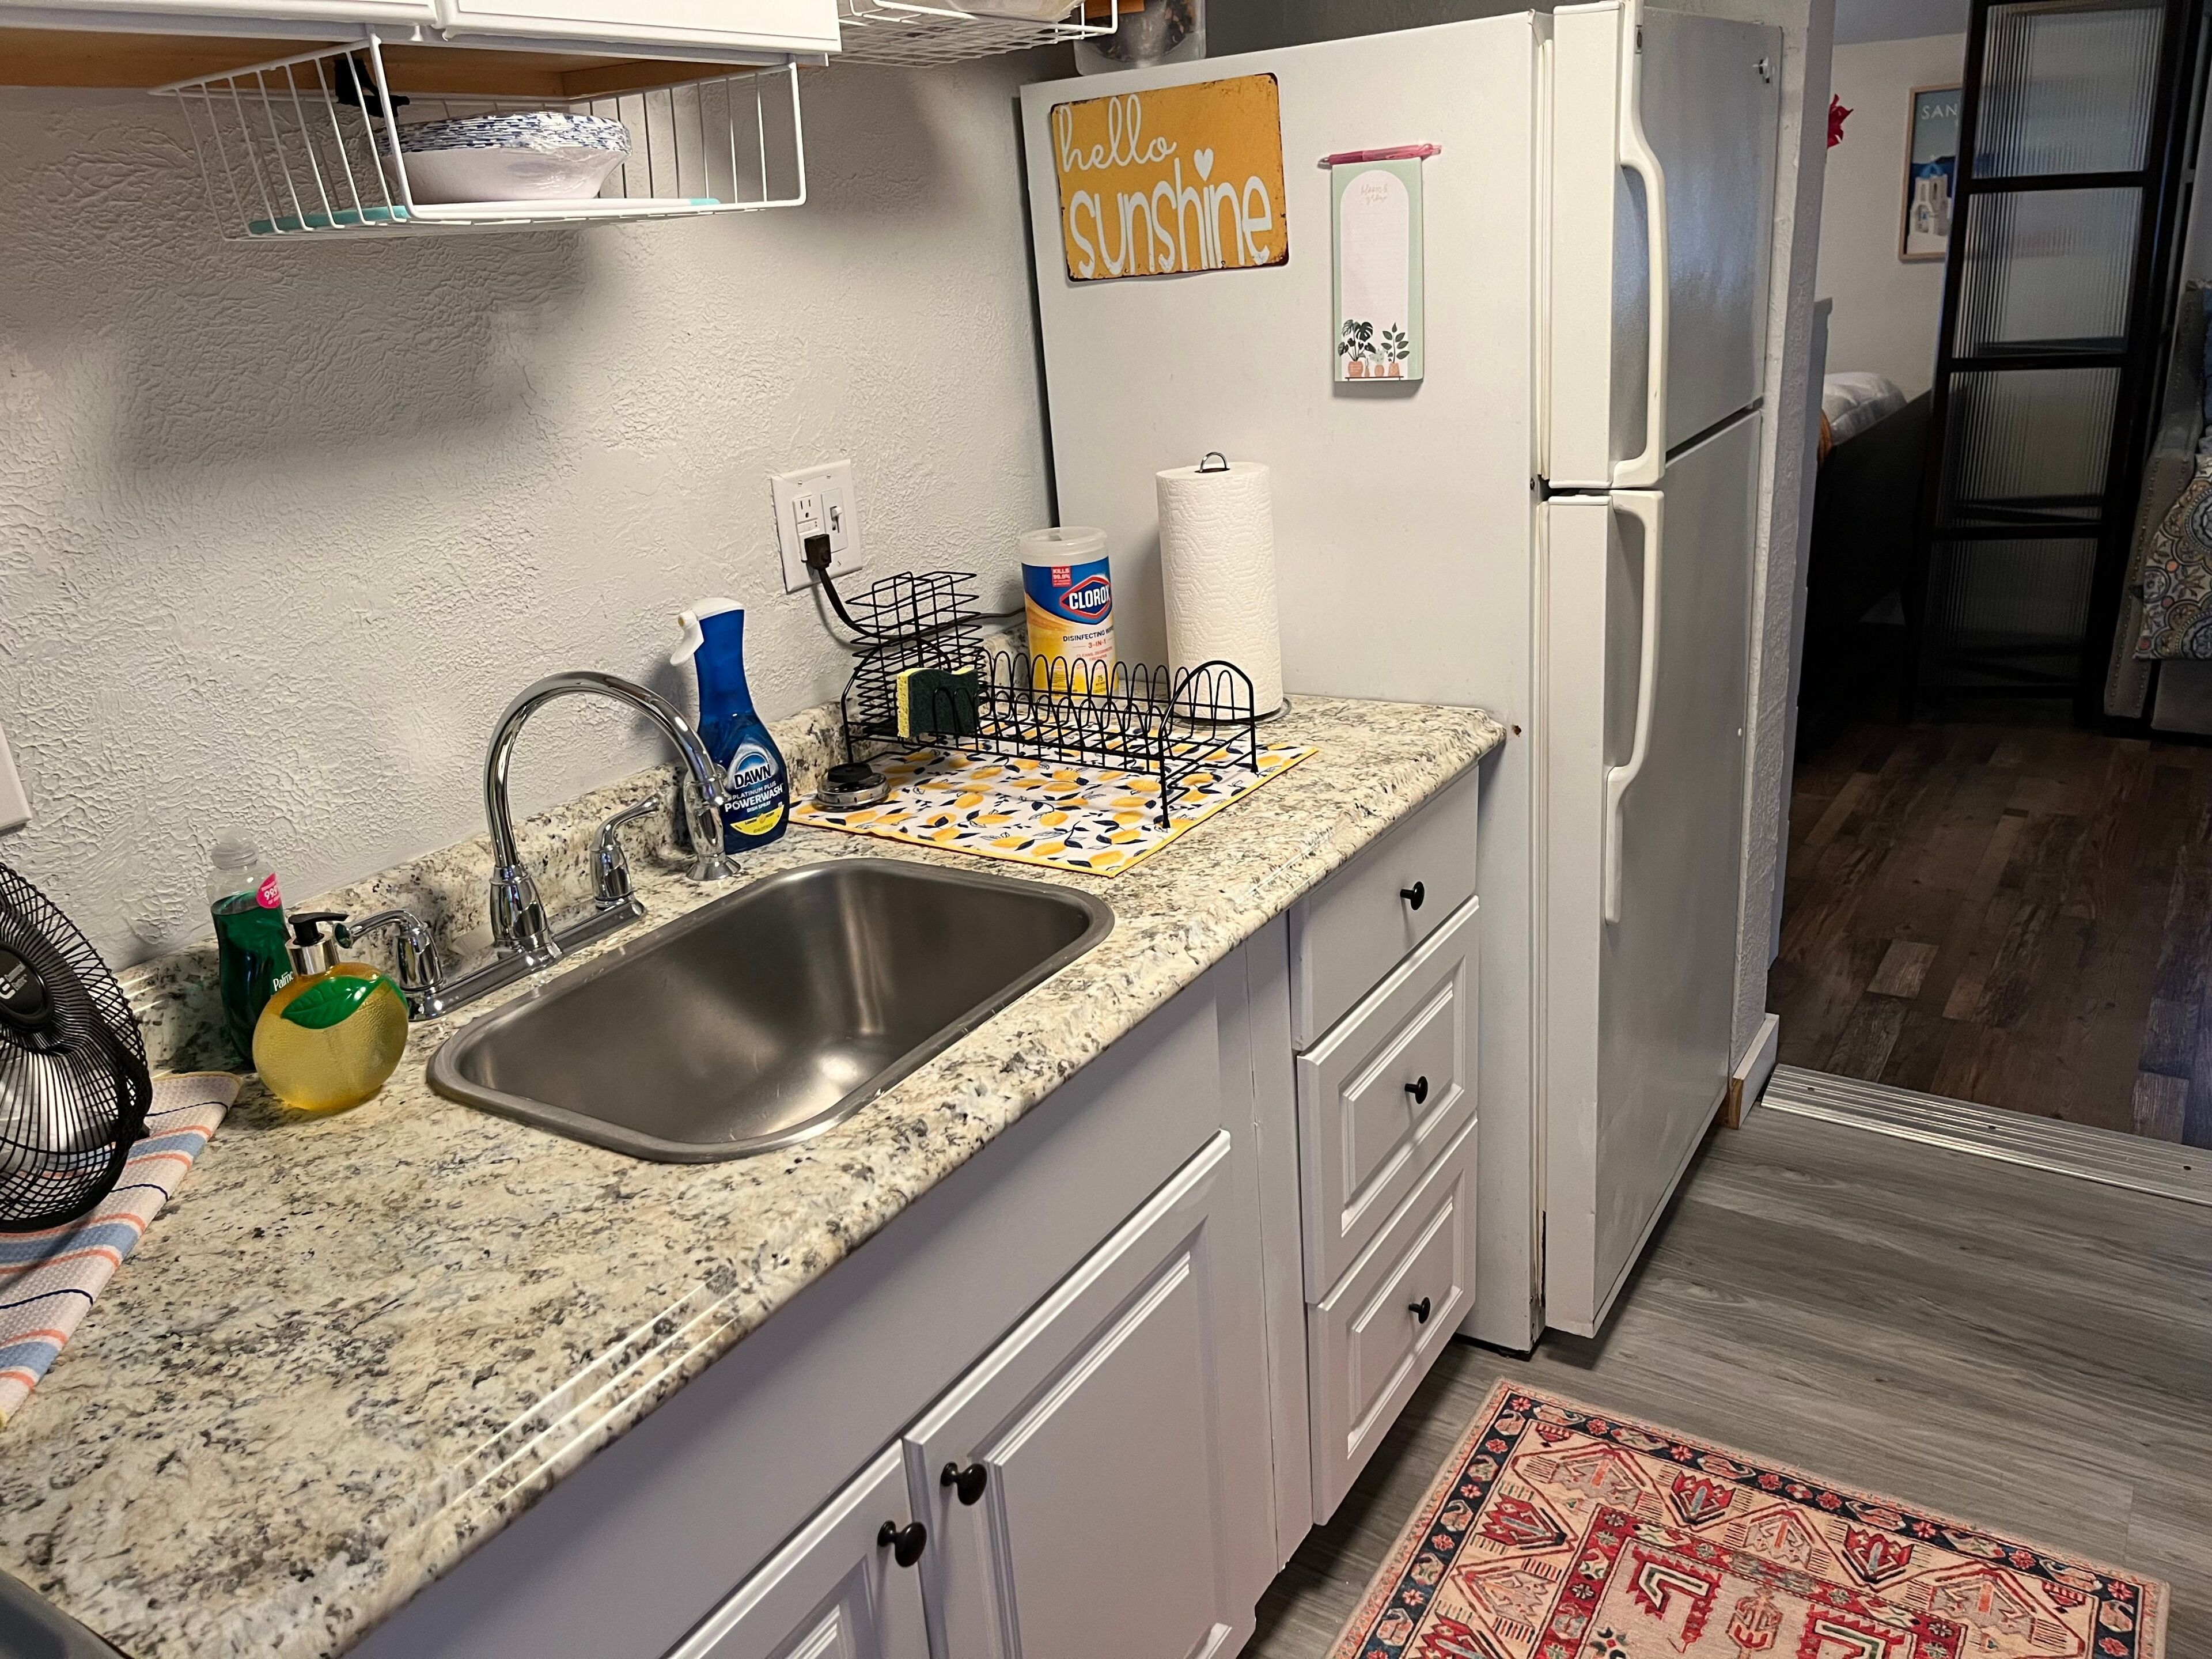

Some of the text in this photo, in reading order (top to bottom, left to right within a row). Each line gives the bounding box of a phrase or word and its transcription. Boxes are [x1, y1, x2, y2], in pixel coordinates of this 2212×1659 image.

[1059, 94, 1177, 172] hello
[1070, 149, 1272, 279] sunshine
[1069, 584, 1109, 609] CLOROX
[1063, 630, 1105, 642] DISINFECTING
[1088, 638, 1106, 648] 3-IN-1
[734, 764, 771, 788] DAWN
[725, 784, 783, 812] POWERWASH
[732, 781, 777, 800] PLATINUM PLUS
